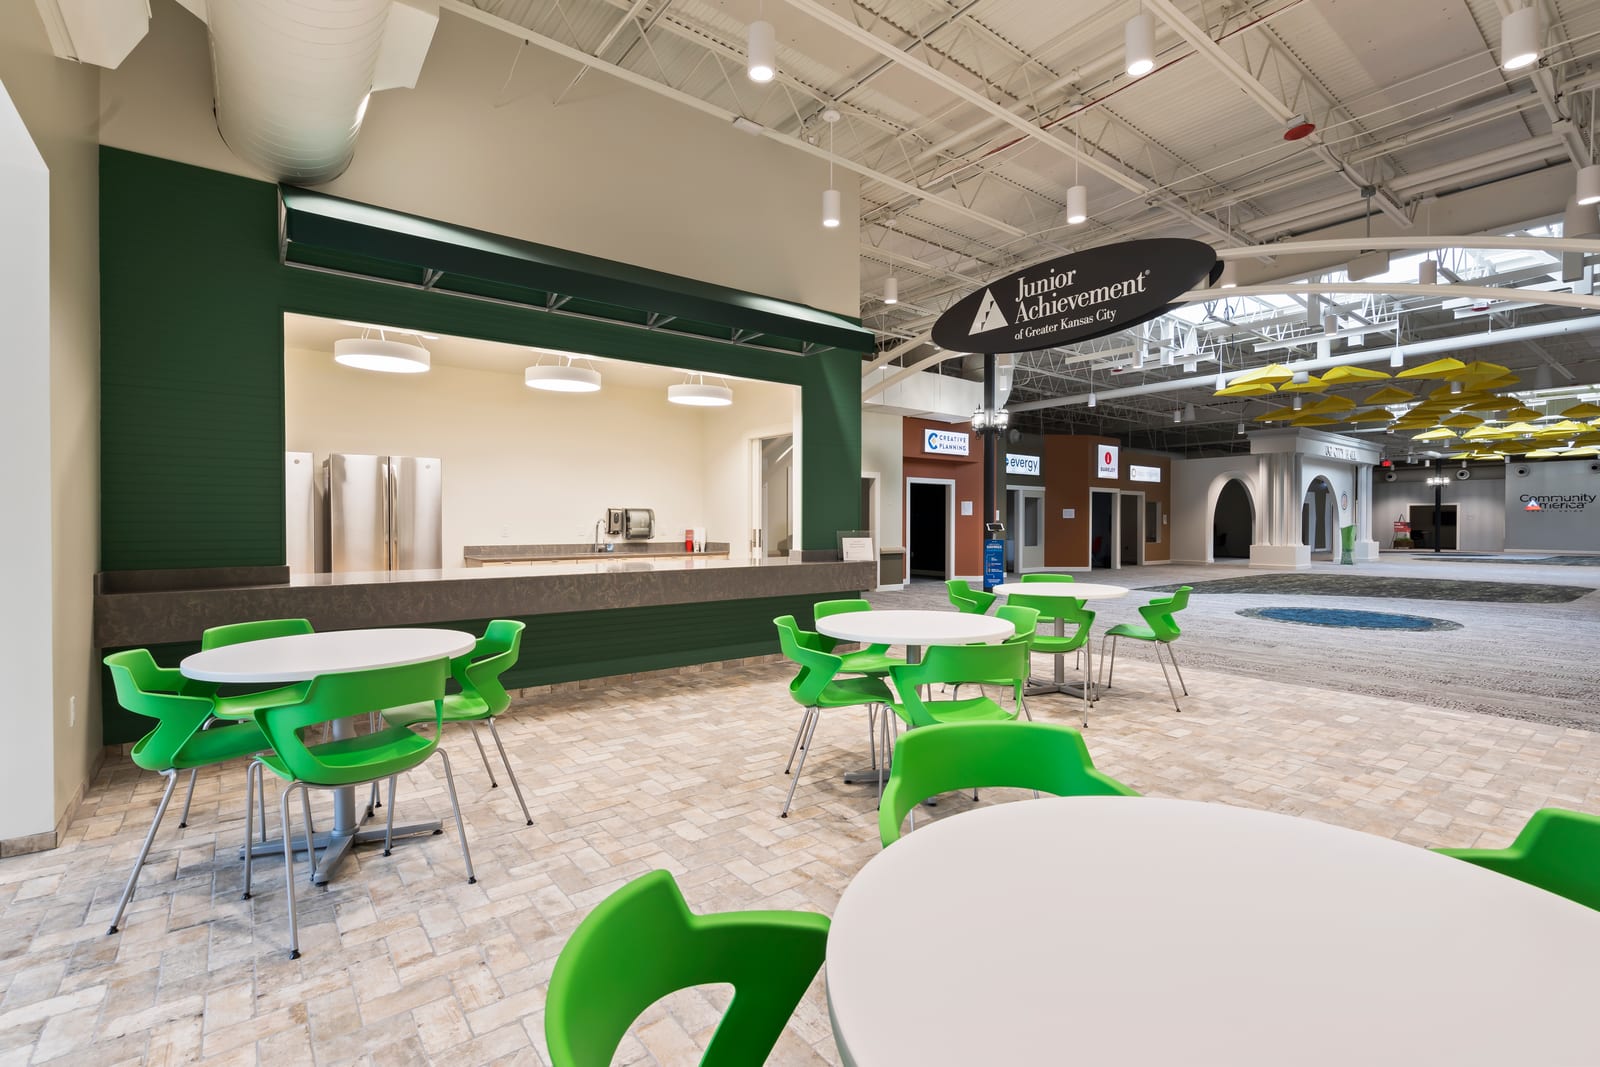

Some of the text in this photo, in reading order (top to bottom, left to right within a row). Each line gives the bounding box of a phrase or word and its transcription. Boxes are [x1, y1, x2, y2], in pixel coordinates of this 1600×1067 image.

[1015, 268, 1077, 302] Junior
[1014, 271, 1146, 324] Achievement
[1014, 308, 1117, 340] of Greater Kansas City
[939, 434, 967, 443] CREATIVE
[939, 443, 967, 451] PLANNING
[1010, 458, 1038, 472] evergy
[1519, 493, 1597, 503] Community
